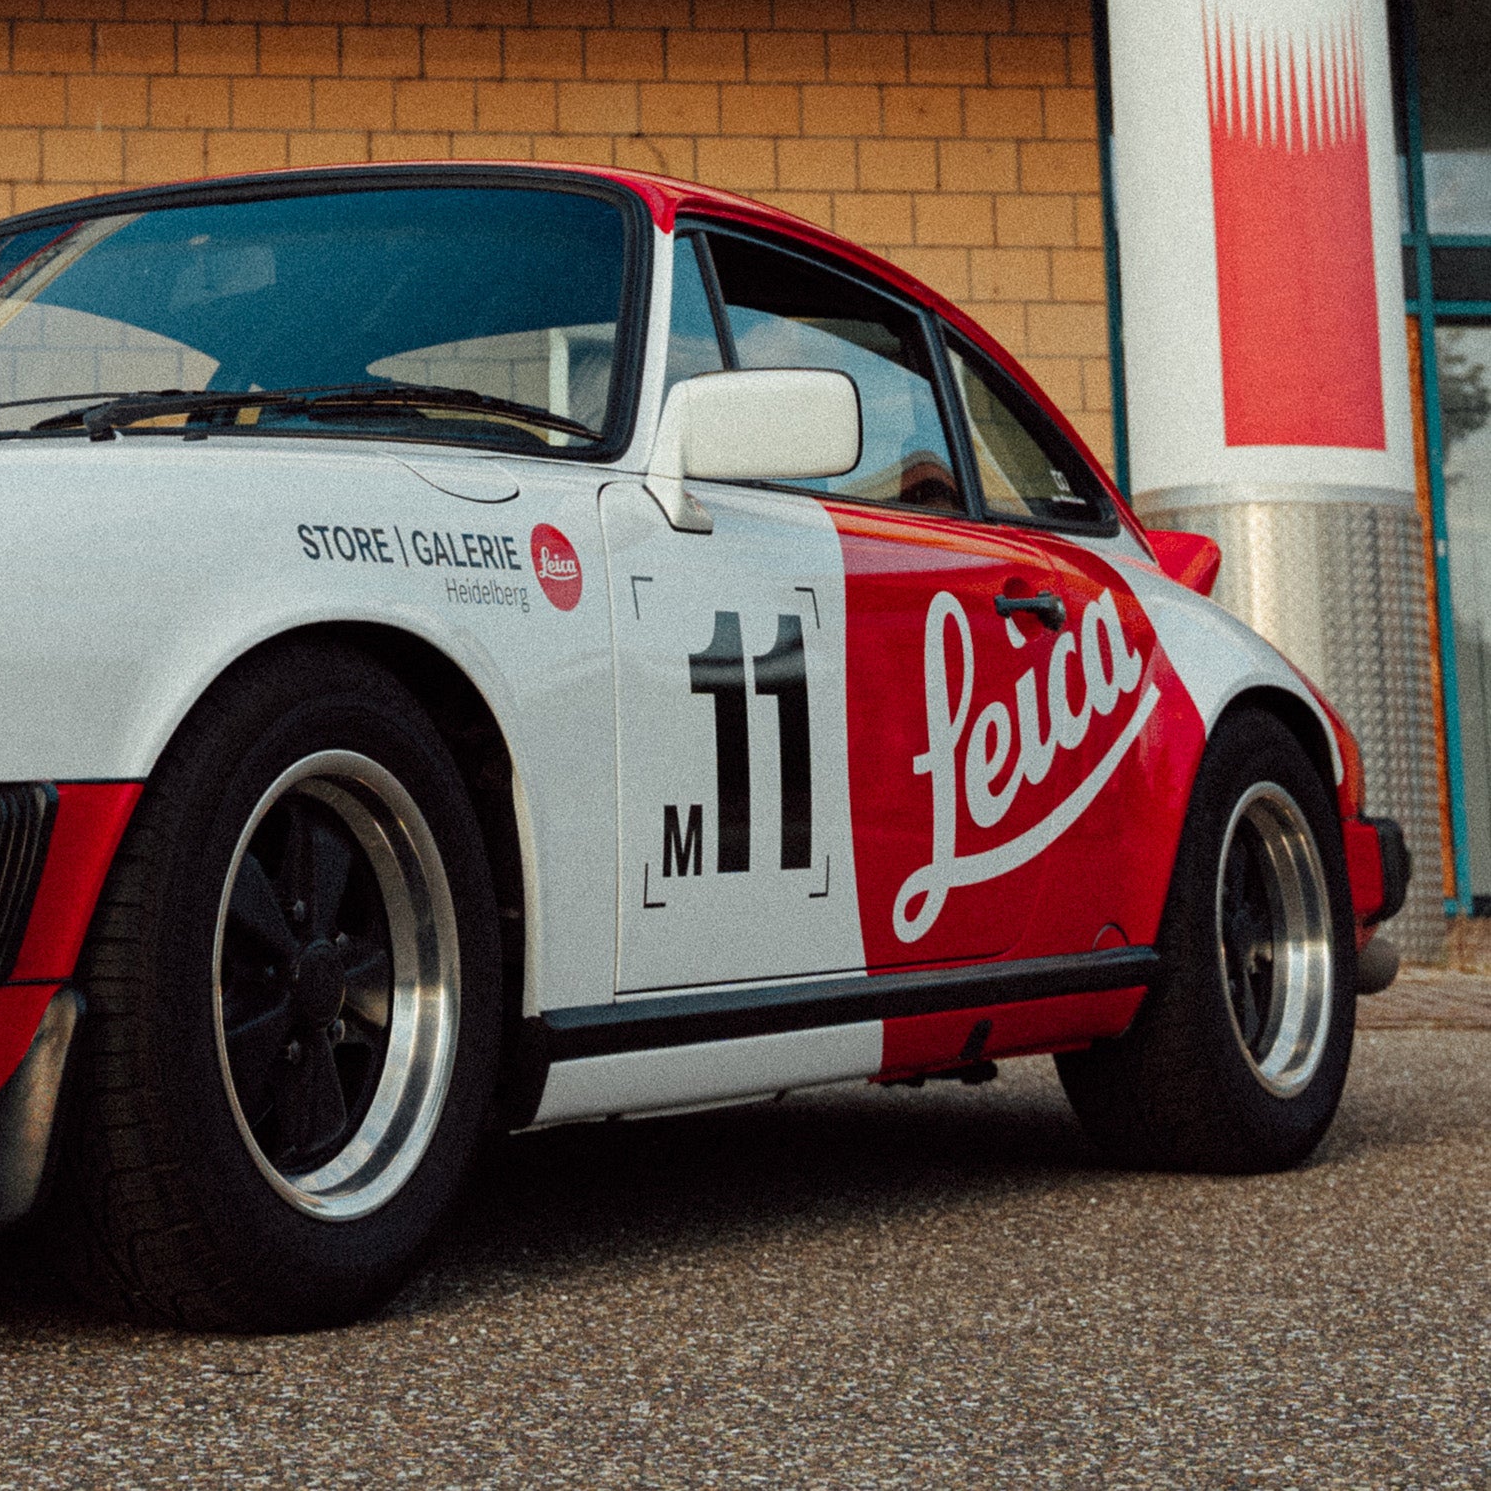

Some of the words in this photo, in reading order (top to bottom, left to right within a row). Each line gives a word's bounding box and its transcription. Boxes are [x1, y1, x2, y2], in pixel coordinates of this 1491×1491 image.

[298, 524, 394, 563] STORE
[411, 530, 522, 570] GALERIE
[539, 546, 579, 580] Leica
[447, 578, 530, 613] Heidelberg
[893, 588, 1160, 943] Leica
